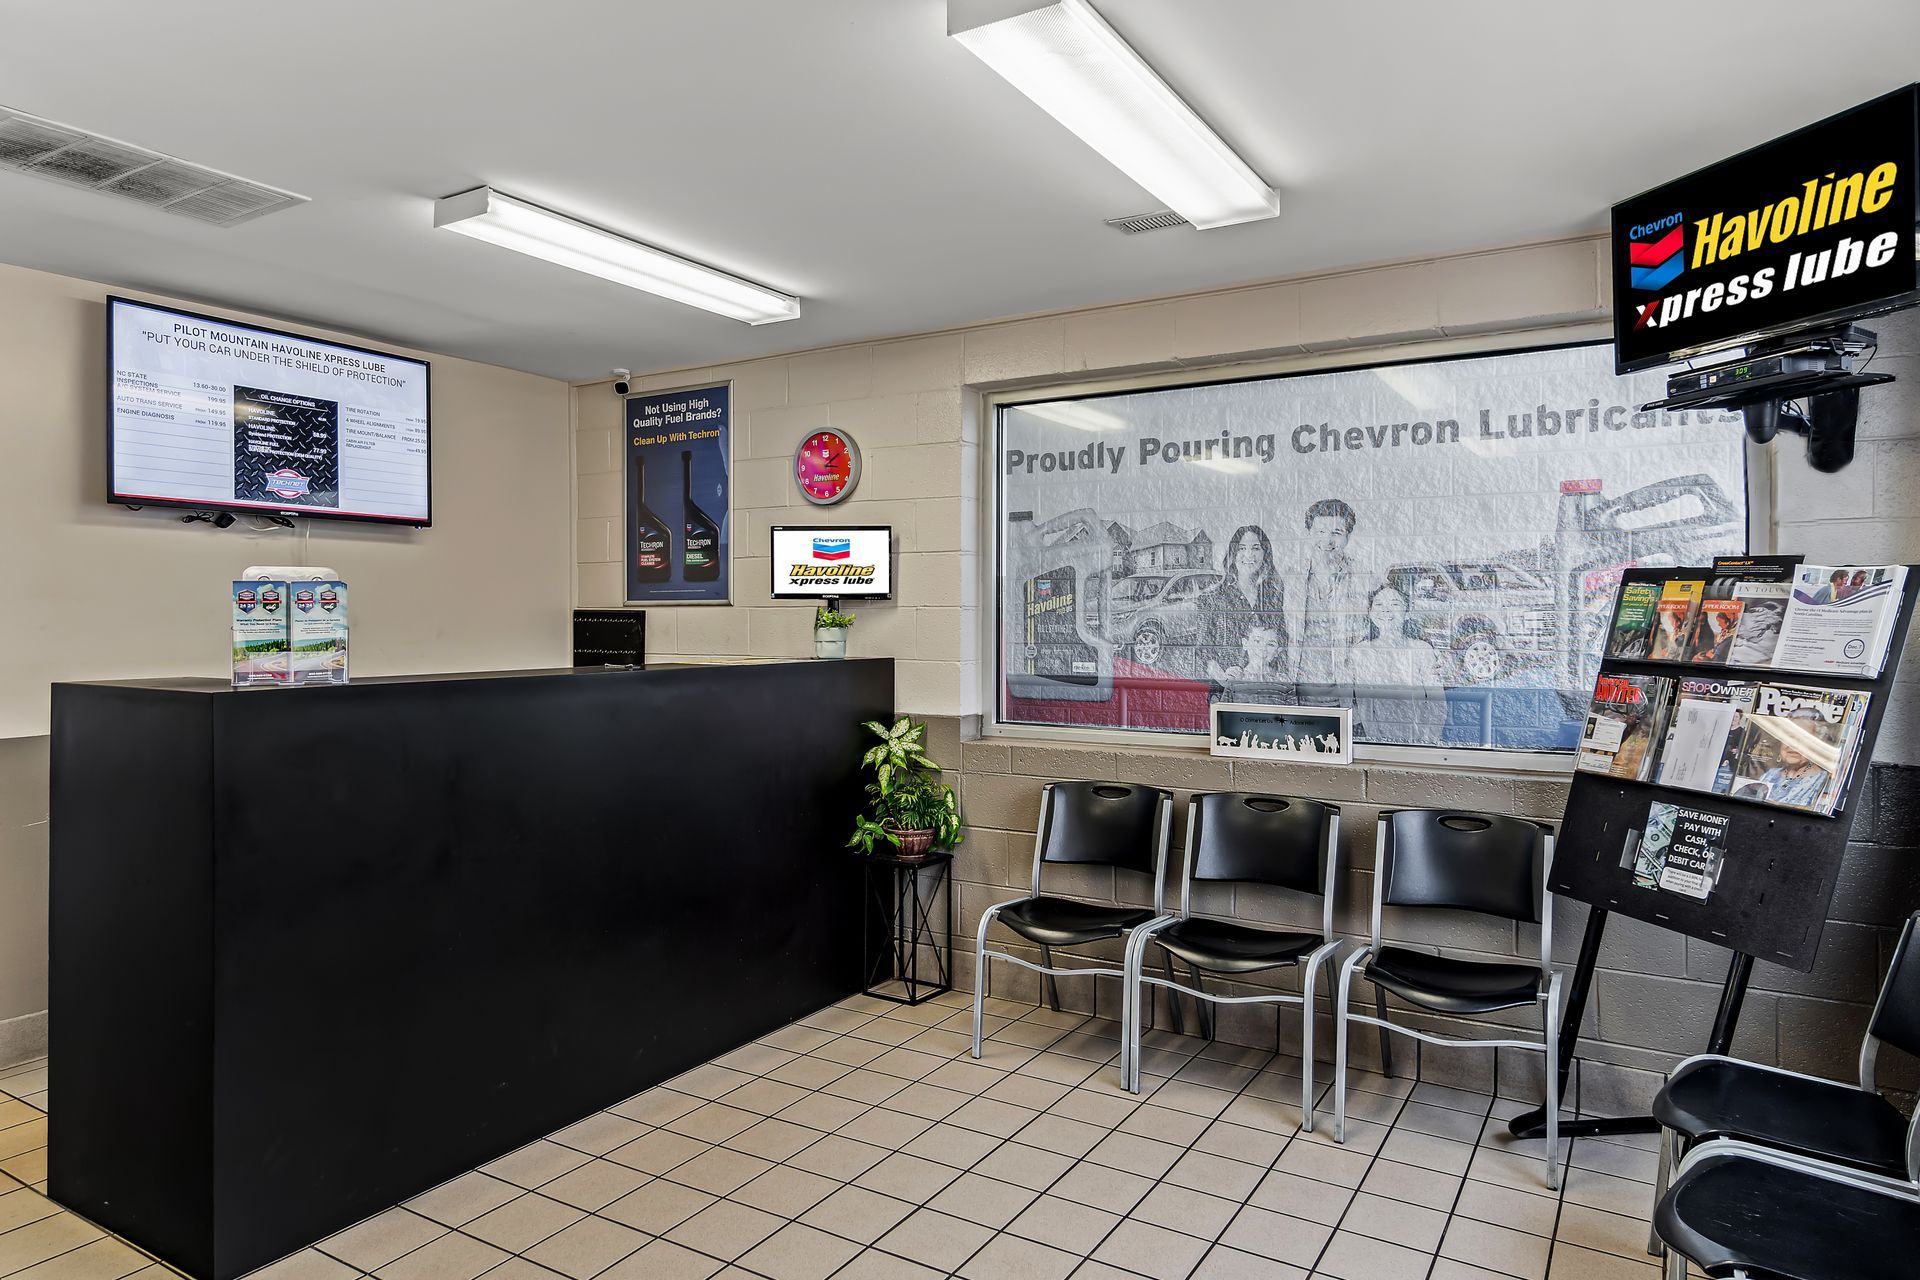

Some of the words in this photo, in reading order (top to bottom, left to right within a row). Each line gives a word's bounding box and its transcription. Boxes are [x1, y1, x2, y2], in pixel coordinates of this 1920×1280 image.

[1691, 161, 1898, 270] Havoline
[1629, 211, 1683, 240] Chevron
[1633, 267, 1775, 331] xpress
[1783, 231, 1899, 292] lube
[174, 323, 207, 338] PILOT
[210, 330, 268, 350] MOUNTAIN
[272, 343, 322, 361] HAVOLINE
[324, 353, 360, 368] XPRESS
[362, 361, 386, 373] LUBE
[142, 331, 171, 344] "PUT
[174, 337, 206, 352] YOUR
[209, 344, 232, 356] CAR
[234, 348, 270, 364] UNDER
[272, 356, 293, 368] THE
[295, 360, 330, 374] SHIELD
[332, 366, 344, 376] OF
[346, 370, 406, 388] PROTECTION"
[117, 377, 158, 388] INSPECTIONS
[128, 372, 148, 380] STATE
[156, 388, 182, 398] SERVICE
[136, 397, 160, 406] TRANS
[161, 400, 182, 410] SERVICE
[270, 396, 292, 404] CHANGE
[293, 400, 316, 408] OPTIONS
[645, 405, 660, 415] Not
[662, 402, 687, 413] Using
[688, 398, 709, 410] High
[117, 408, 140, 416] ENGINE
[142, 410, 174, 420] DIAGNOSIS
[208, 420, 226, 428] 119.95
[270, 418, 296, 426] PROTECTION
[633, 416, 663, 428] Quality
[665, 413, 683, 424] Fuel
[686, 408, 722, 422] Brands?
[366, 421, 395, 430] ALIGNMENTS
[357, 430, 396, 440] MOUNT/BALANCE
[634, 436, 655, 446] Clean
[656, 434, 668, 445] Up
[669, 432, 687, 442] With
[688, 429, 720, 440] Techron
[1006, 441, 1126, 475] Proudly
[1139, 429, 1275, 466] Pouring
[1291, 418, 1460, 454] Chevron
[814, 474, 840, 482] Havoline
[789, 564, 875, 576] Havoline
[789, 577, 840, 586] xpress
[843, 576, 874, 584] lube
[1626, 587, 1654, 596] Safety
[1027, 594, 1073, 617] Havoline
[1600, 674, 1629, 686] American
[1595, 684, 1641, 704] HUNTER
[1678, 809, 1699, 820] SAVE
[1698, 813, 1728, 826] MONEY
[1684, 822, 1700, 832] PAY
[1700, 826, 1722, 836] WITH
[1685, 834, 1708, 847] CASH,
[1673, 844, 1700, 858] CHECK,
[1702, 850, 1715, 860] OR
[1668, 854, 1689, 866] DEBIT
